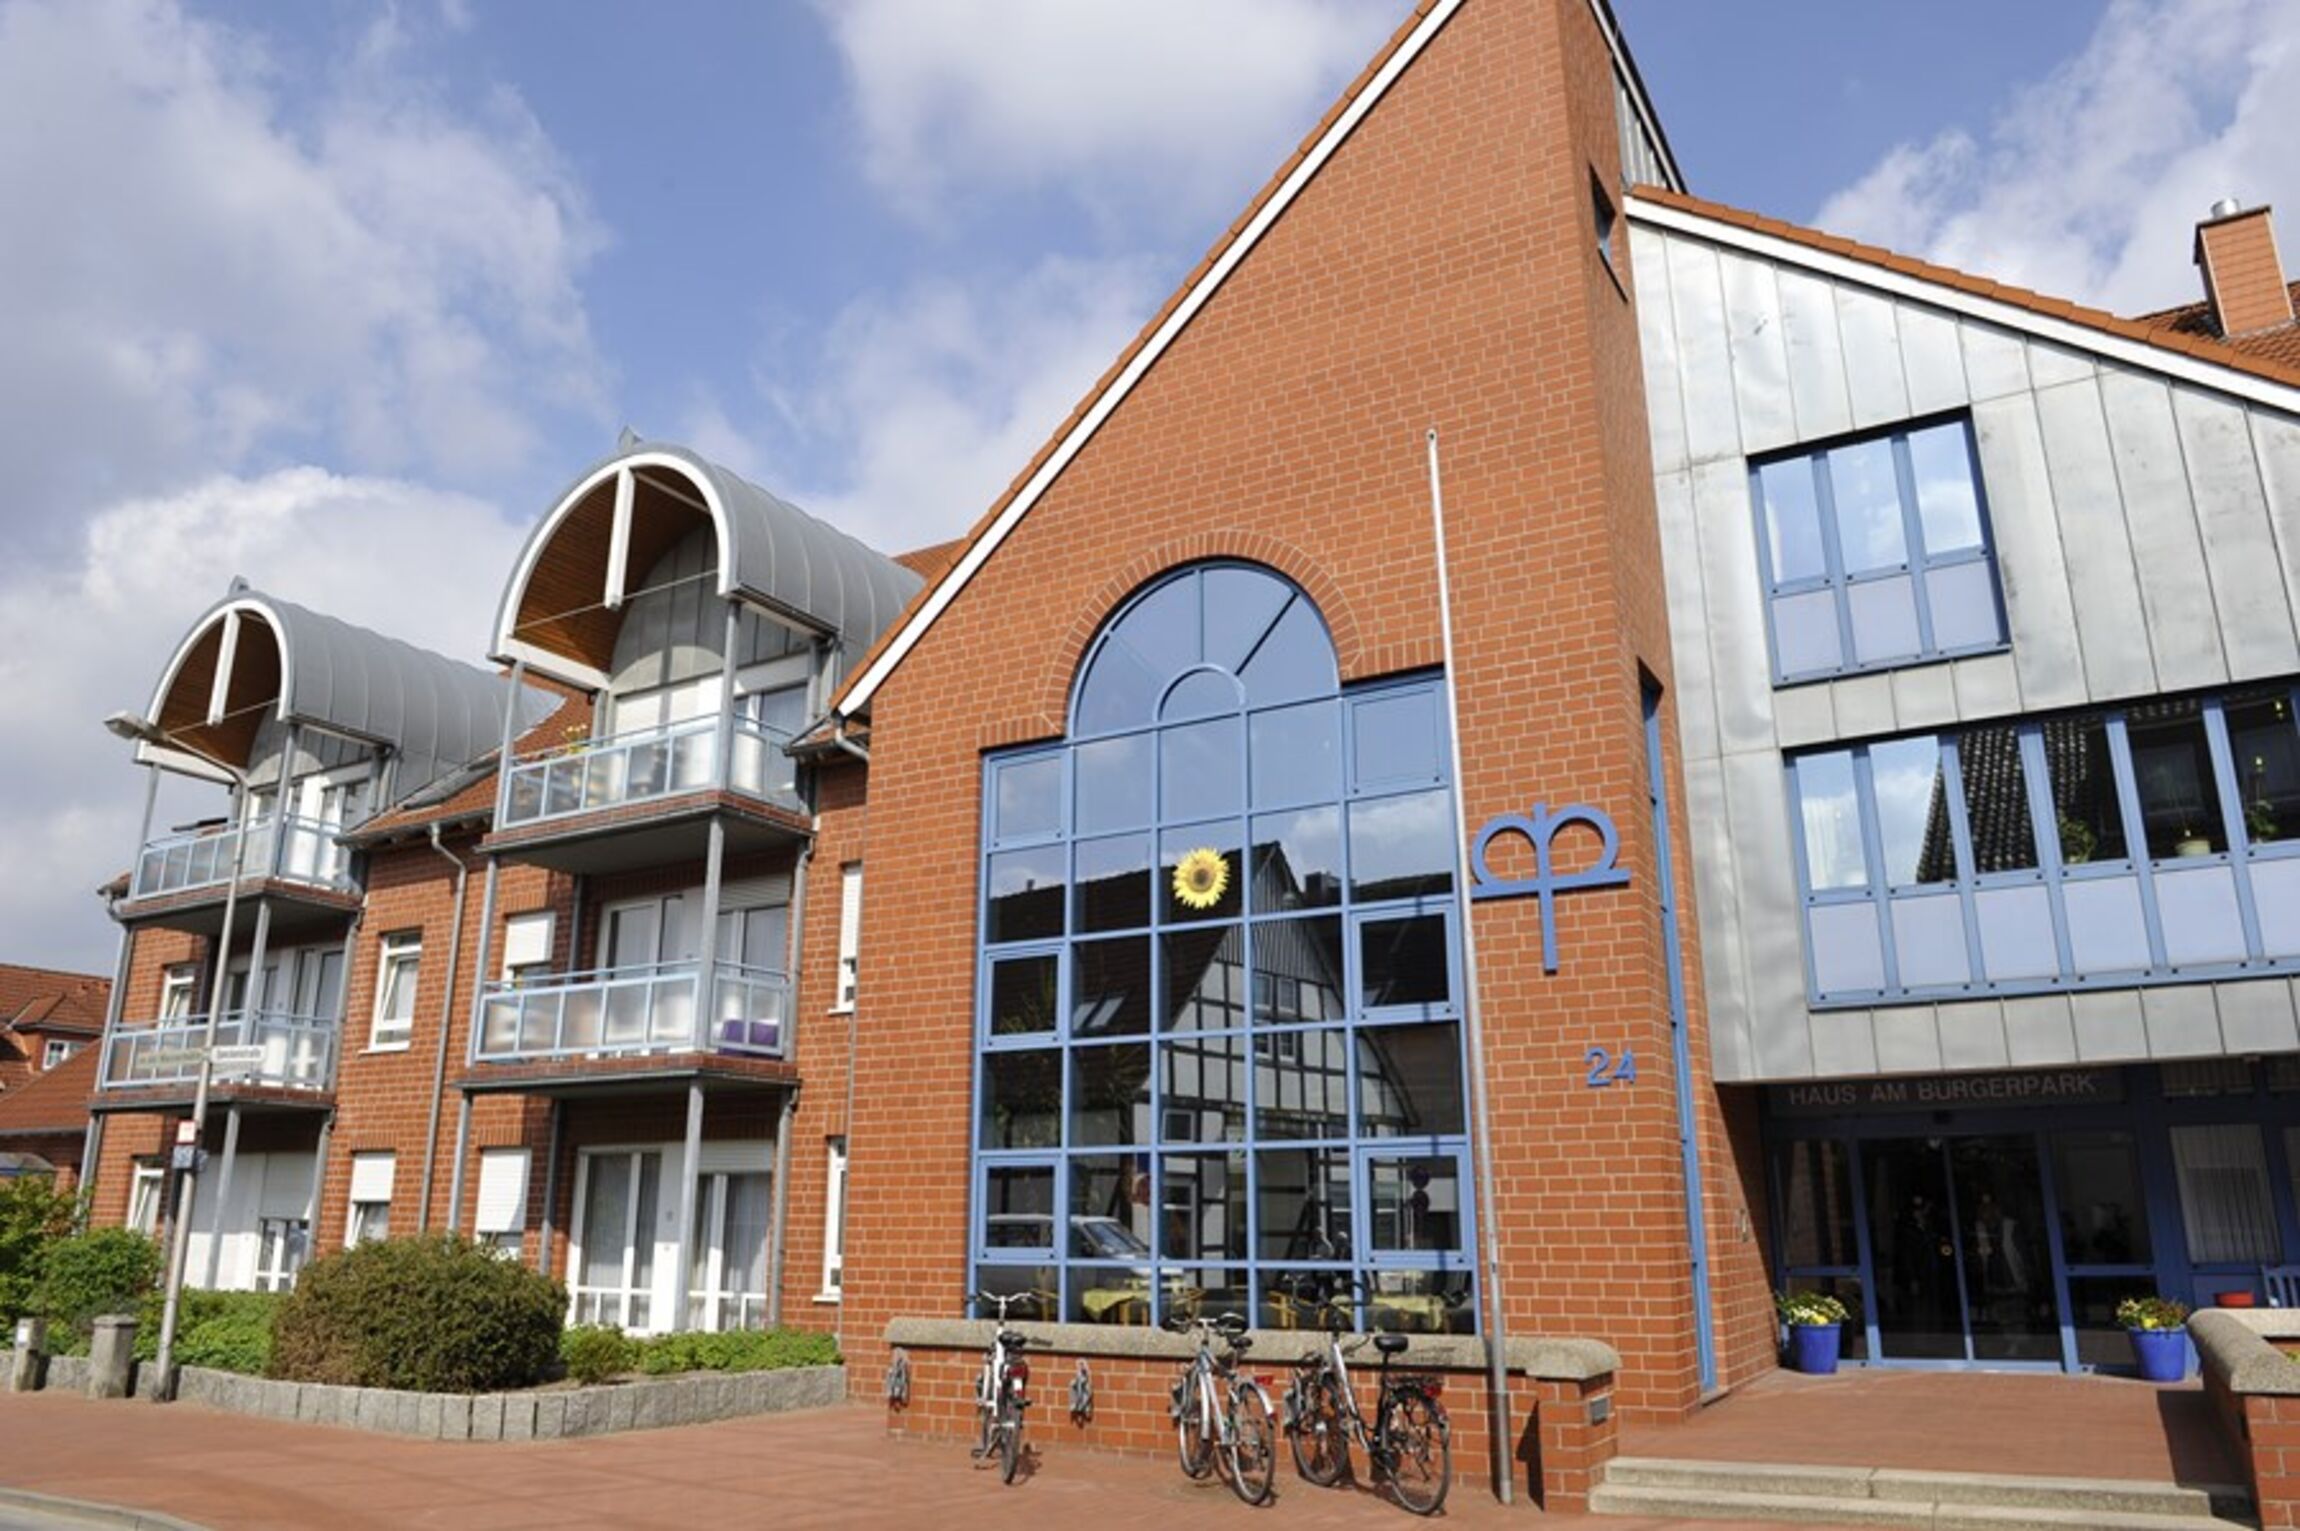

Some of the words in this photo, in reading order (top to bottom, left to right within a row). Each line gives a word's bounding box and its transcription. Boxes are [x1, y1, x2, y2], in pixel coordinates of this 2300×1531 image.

[1585, 1047, 1637, 1087] 24
[1789, 1085, 1856, 1105] HAUS
[1871, 1082, 1907, 1101] AM
